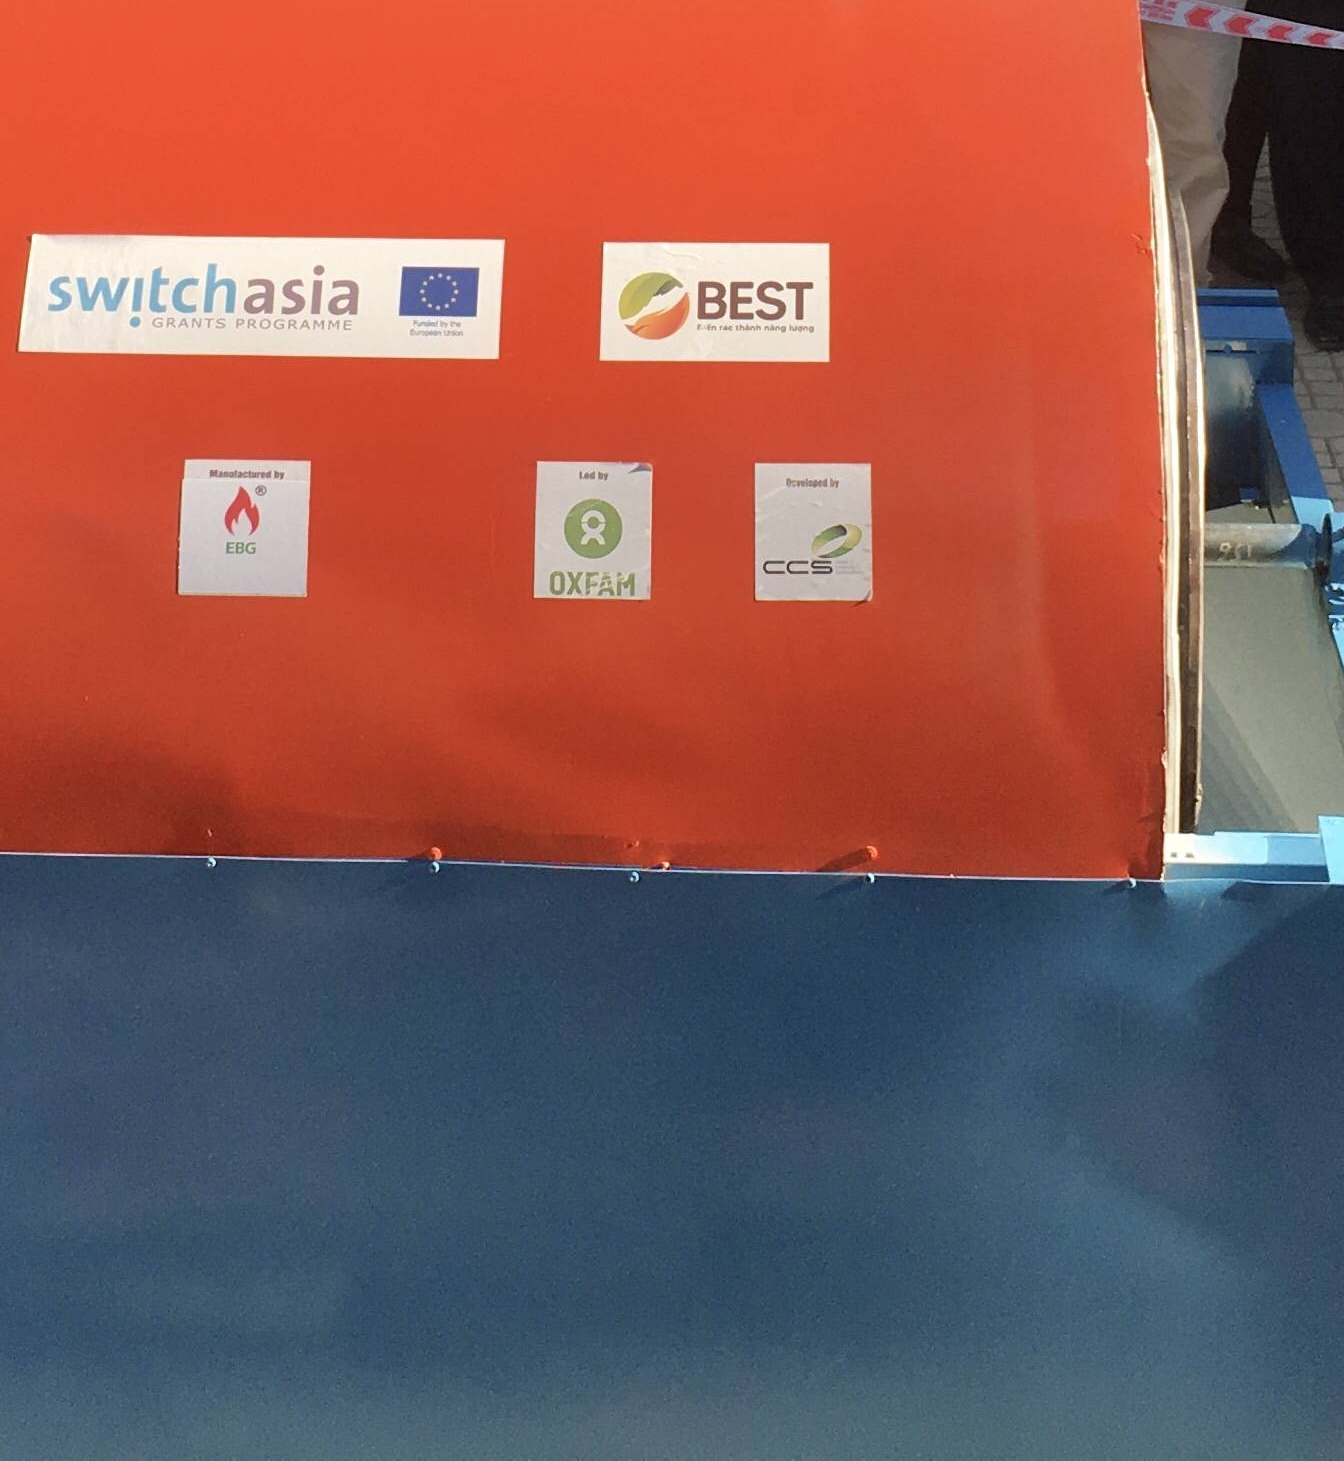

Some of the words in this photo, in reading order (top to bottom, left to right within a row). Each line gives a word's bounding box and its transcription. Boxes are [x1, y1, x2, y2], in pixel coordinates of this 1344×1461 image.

[697, 281, 814, 321] BEST
[152, 318, 226, 330] GRANTS
[236, 318, 353, 331] PROGRAMME
[209, 470, 271, 479] Manufactured
[273, 470, 285, 480] by
[579, 471, 596, 480] Led
[598, 471, 609, 481] by
[786, 478, 827, 488] Developed
[829, 478, 840, 489] by
[225, 542, 256, 555] EBG
[762, 560, 833, 575] CCS
[549, 570, 636, 597] OXFAM
